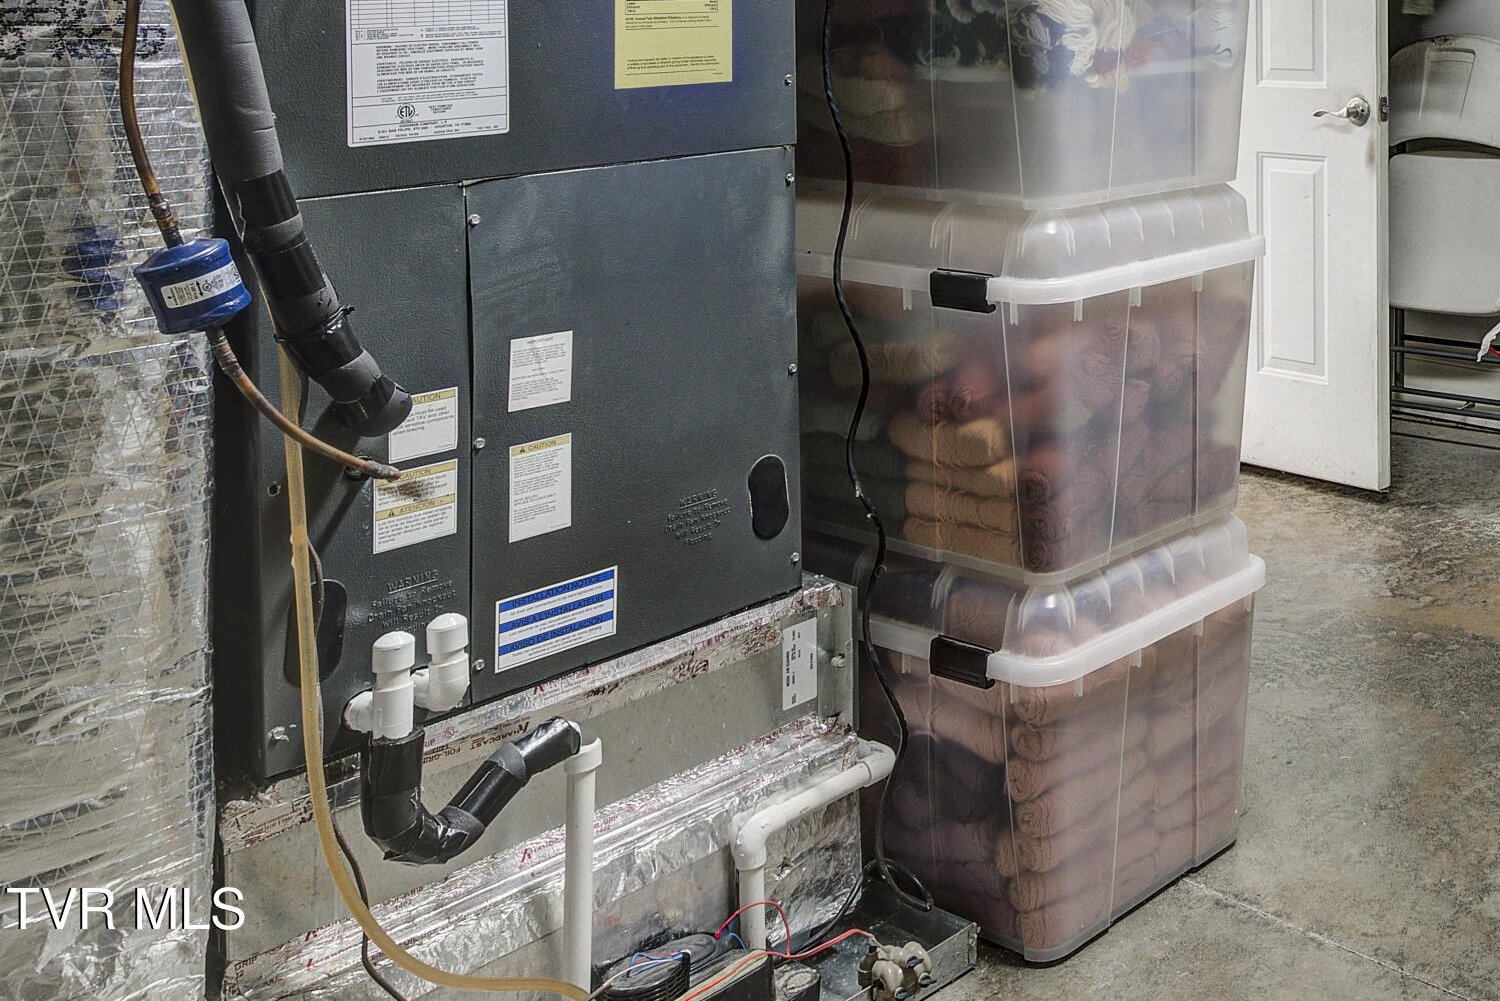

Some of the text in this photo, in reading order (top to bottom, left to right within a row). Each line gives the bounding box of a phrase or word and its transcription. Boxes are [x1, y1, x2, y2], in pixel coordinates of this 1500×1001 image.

[411, 392, 441, 403] AUTION
[527, 439, 557, 452] CAUTION
[679, 488, 718, 507] WARNING
[387, 568, 439, 592] WARNING
[371, 596, 404, 608] Failure
[421, 579, 454, 593] Remove
[512, 575, 602, 607] INSTALLATION NOTICE
[367, 609, 393, 623] Drain
[510, 617, 531, 630] AVIS
[509, 637, 536, 653] AVISO
[469, 729, 520, 750] HARDCAST
